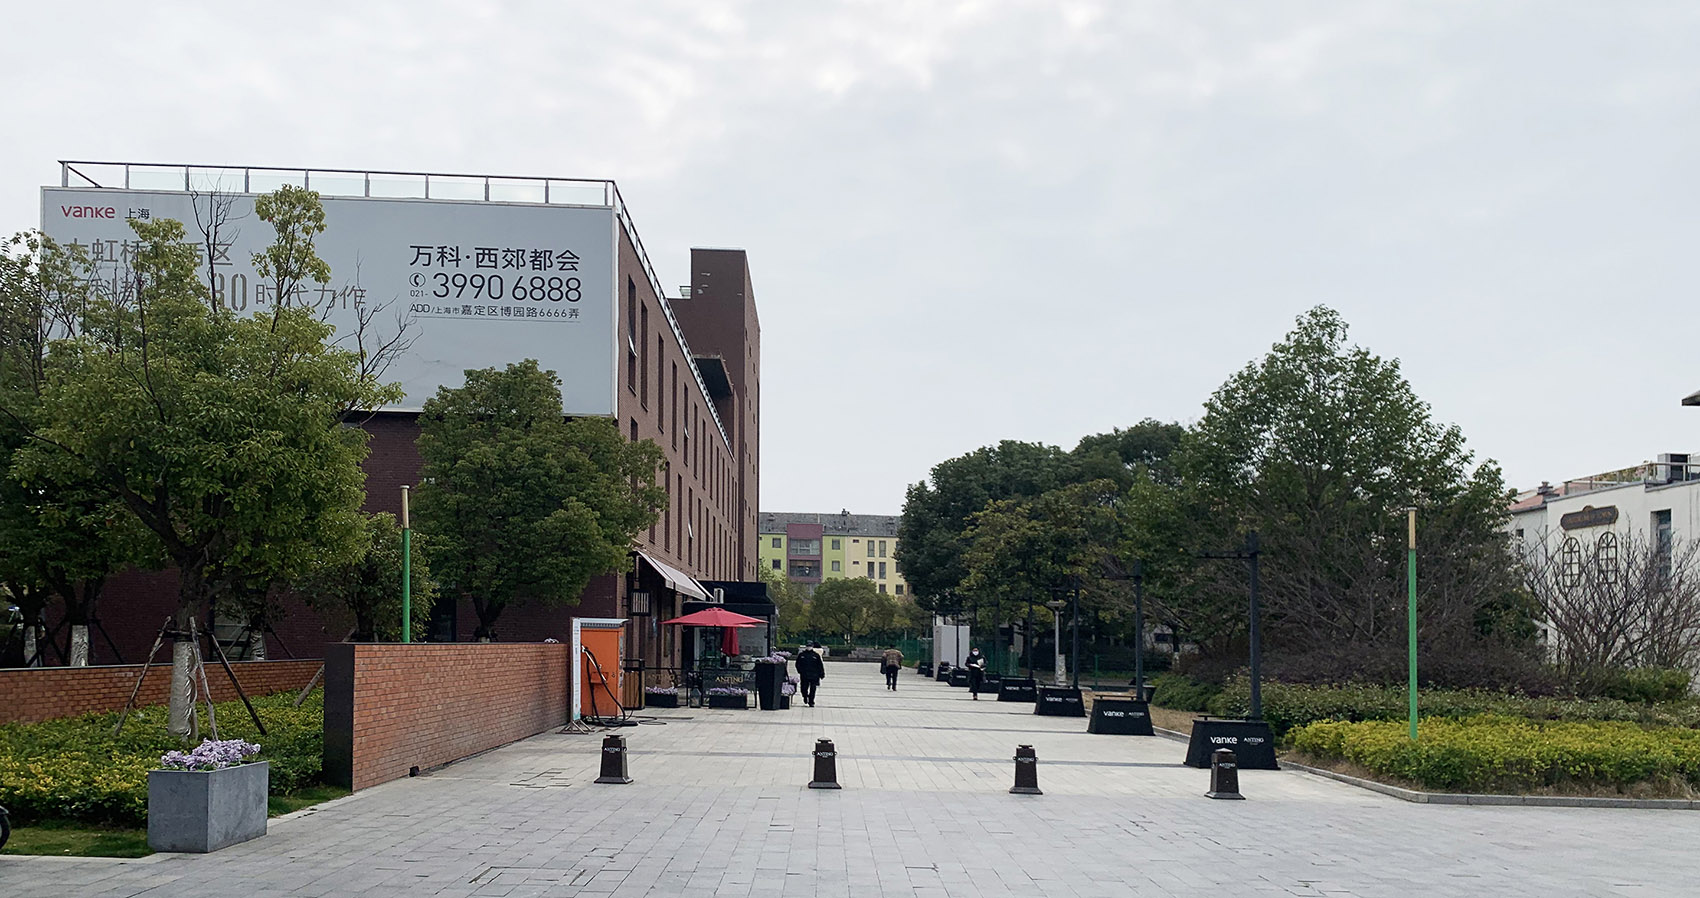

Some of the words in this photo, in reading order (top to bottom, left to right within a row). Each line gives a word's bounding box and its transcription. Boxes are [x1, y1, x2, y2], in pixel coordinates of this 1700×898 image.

[61, 205, 116, 218] vanke
[125, 207, 150, 219] 上海
[409, 244, 580, 272] 万科·西郊都会
[432, 272, 504, 300] 3990
[511, 275, 582, 302] 6888
[1210, 736, 1238, 744] vanke
